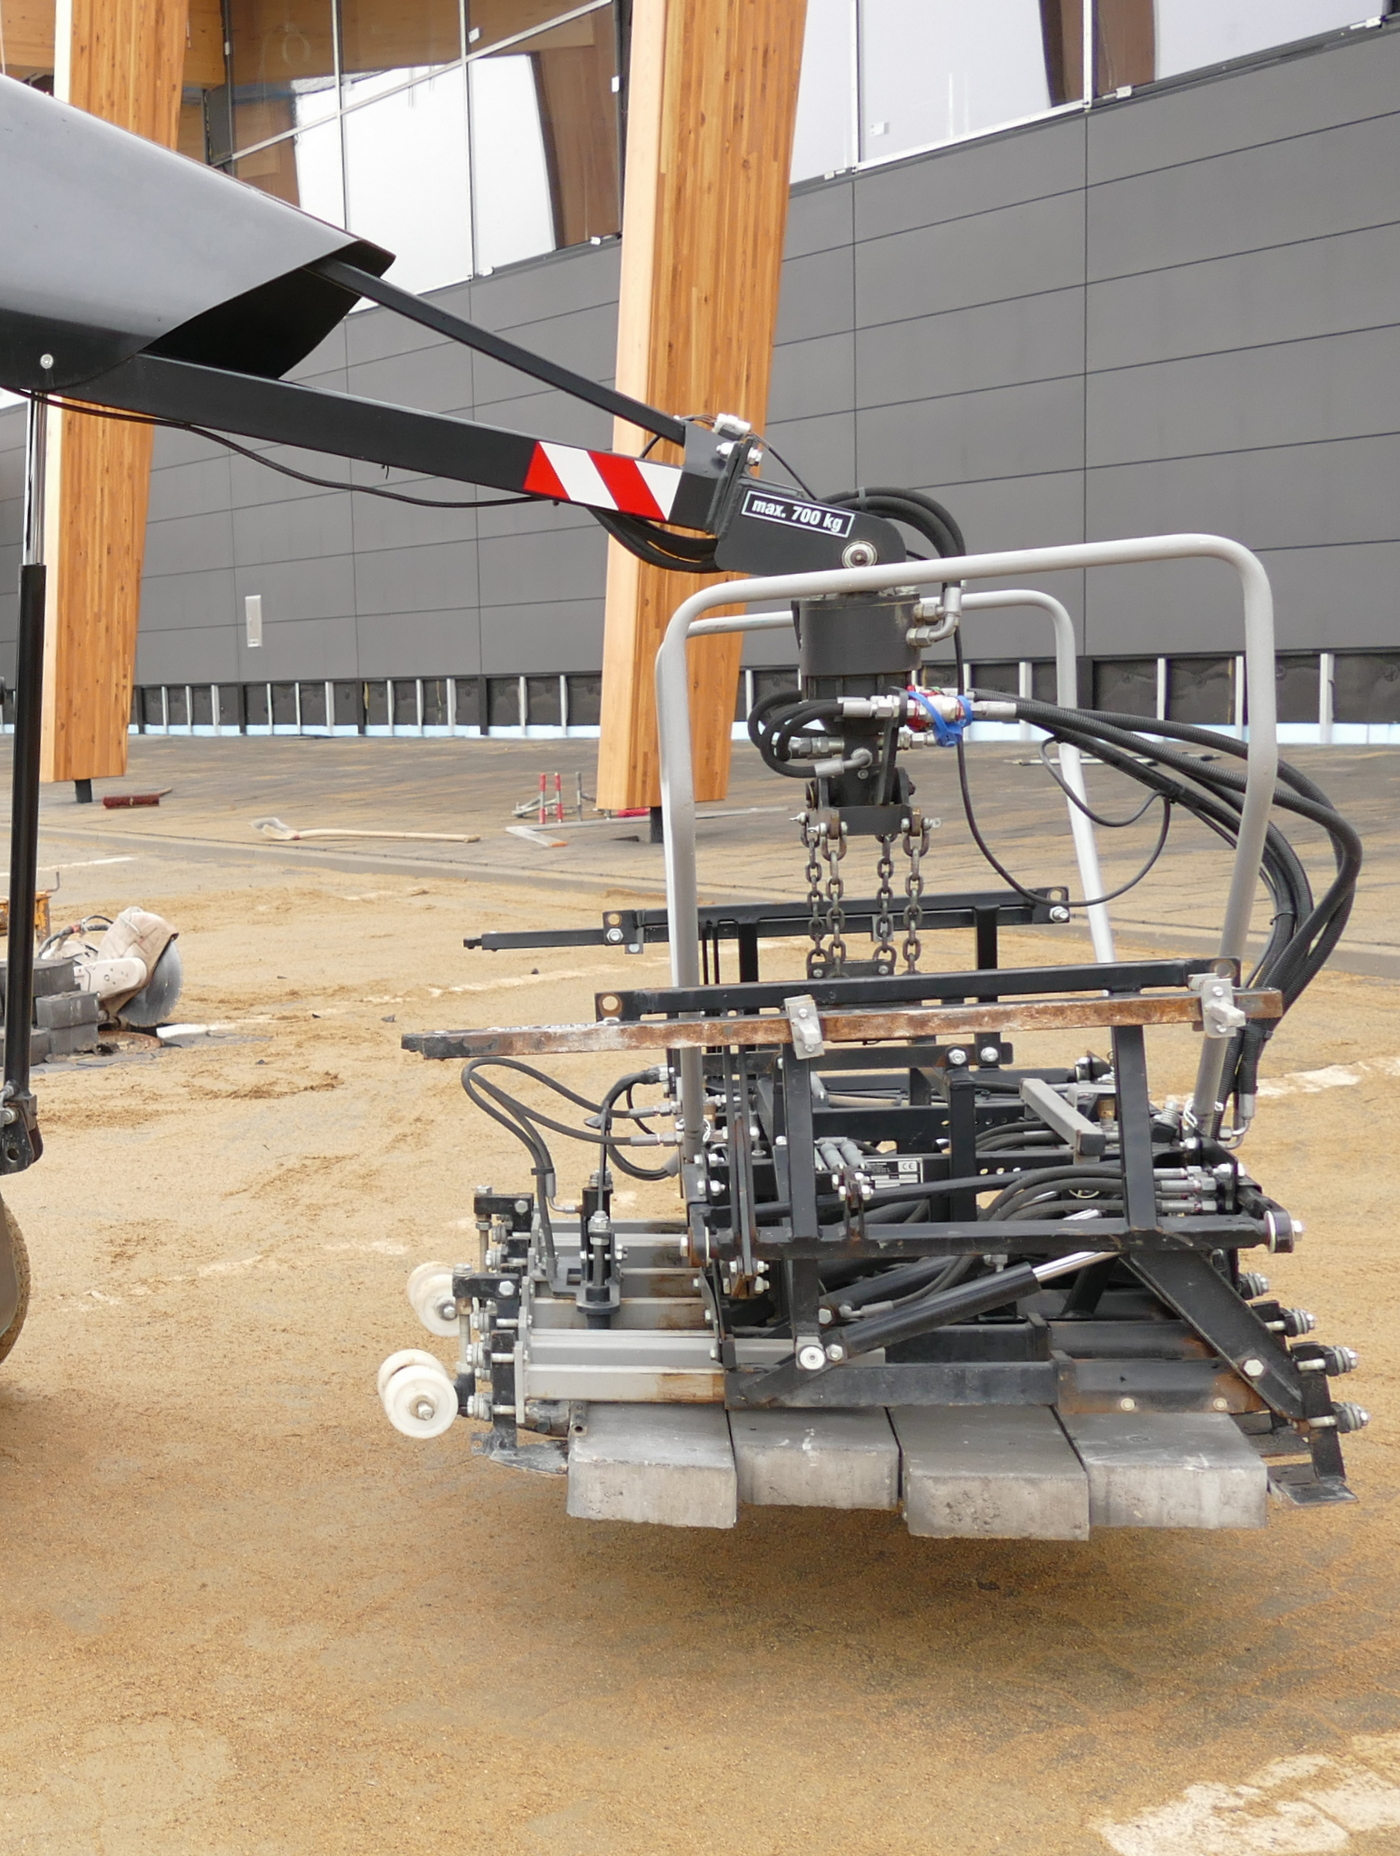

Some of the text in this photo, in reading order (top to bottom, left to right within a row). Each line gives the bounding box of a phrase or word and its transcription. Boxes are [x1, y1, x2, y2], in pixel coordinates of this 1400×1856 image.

[751, 499, 843, 533] max. 700 kg
